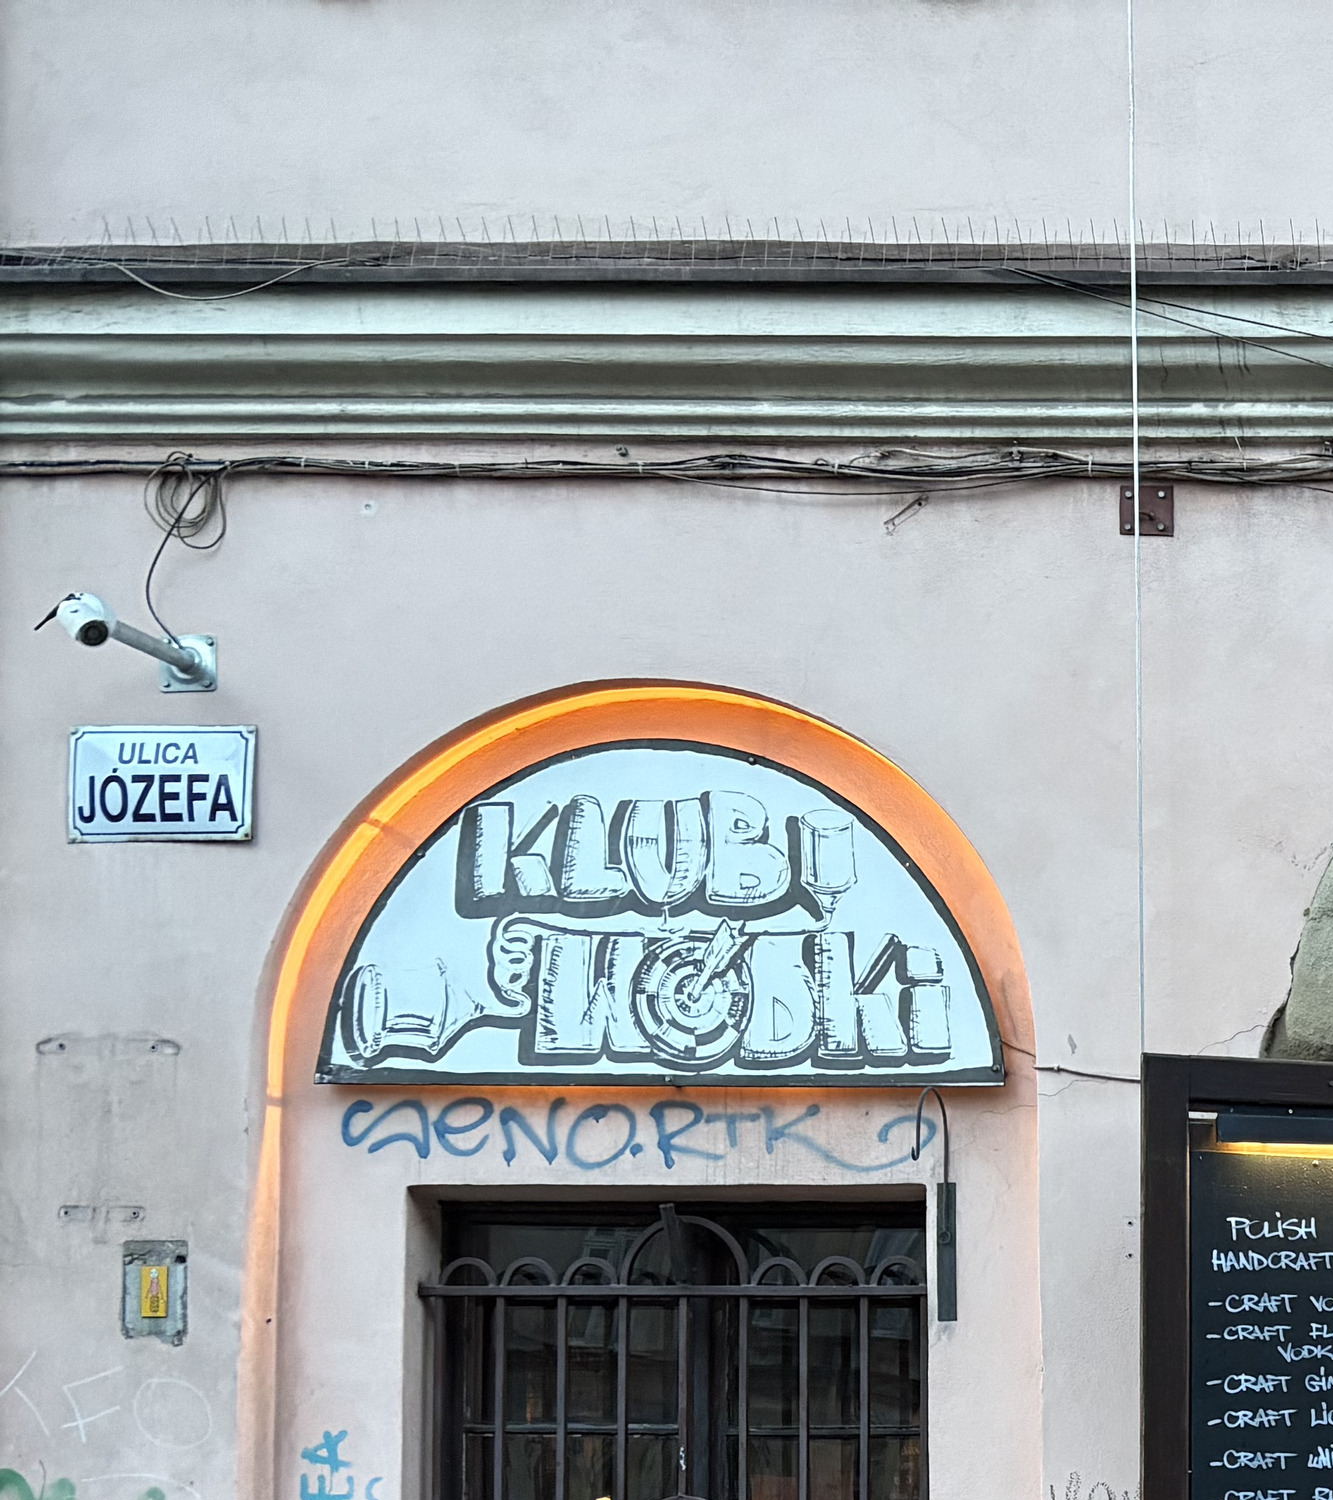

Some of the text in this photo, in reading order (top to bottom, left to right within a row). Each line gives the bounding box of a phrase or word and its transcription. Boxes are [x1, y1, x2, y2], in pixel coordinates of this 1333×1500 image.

[118, 742, 199, 765] ULICA
[78, 768, 238, 823] JÓZEFA
[455, 791, 789, 919] KLUB
